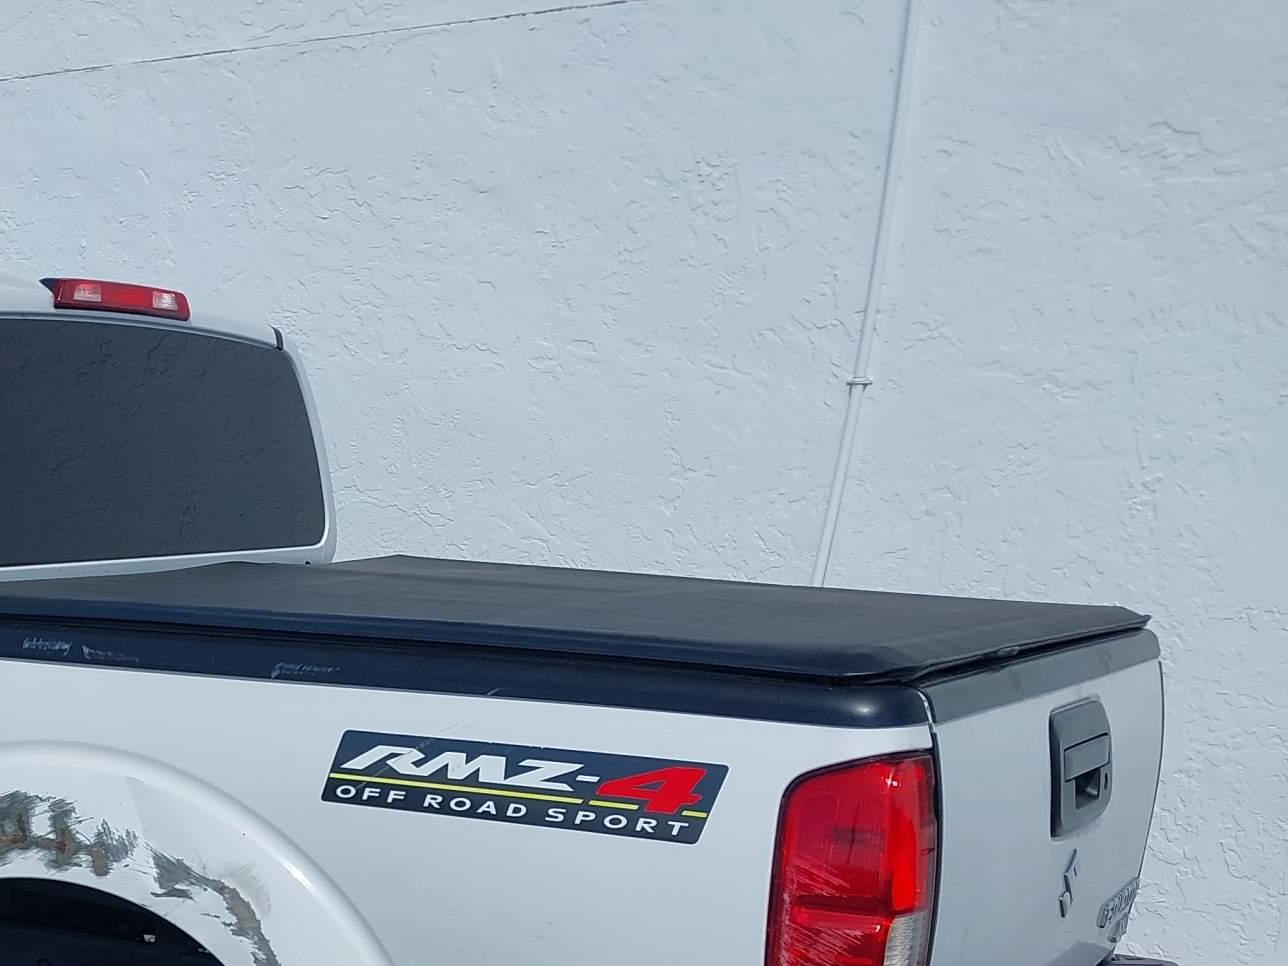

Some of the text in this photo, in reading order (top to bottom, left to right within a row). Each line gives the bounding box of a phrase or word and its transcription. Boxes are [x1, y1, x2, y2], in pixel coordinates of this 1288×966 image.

[340, 745, 707, 815] RMZ-4
[336, 785, 689, 836] OFF ROAD SPORT
